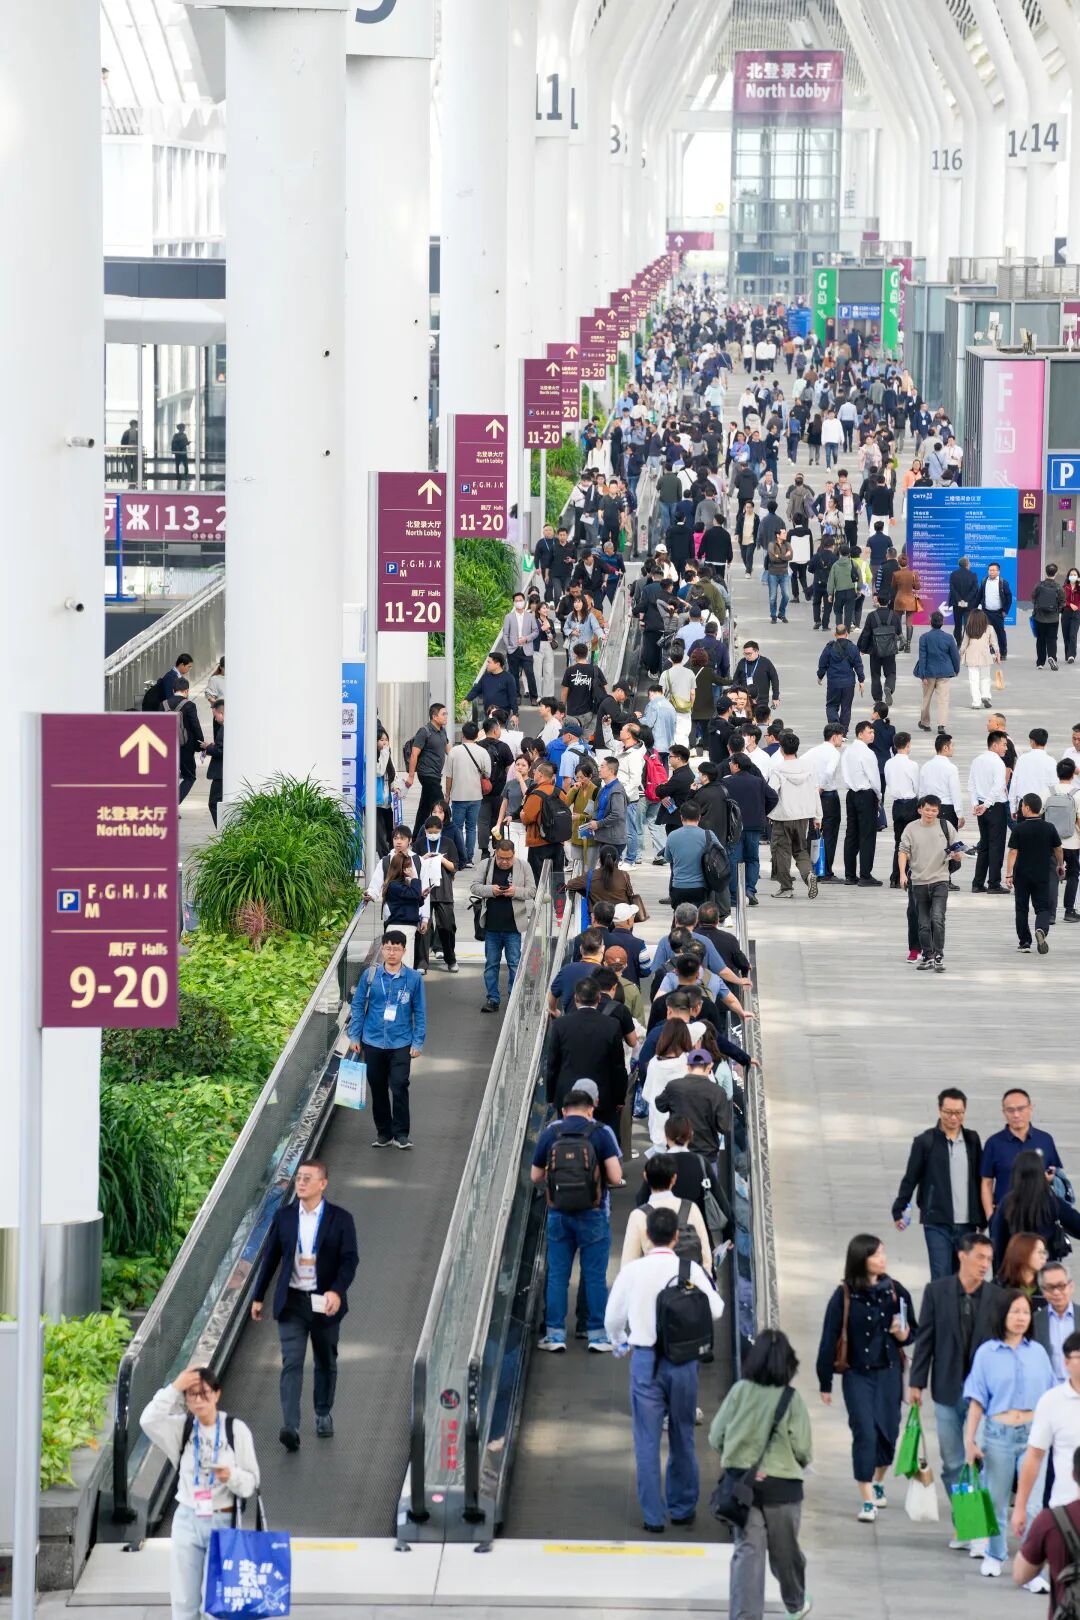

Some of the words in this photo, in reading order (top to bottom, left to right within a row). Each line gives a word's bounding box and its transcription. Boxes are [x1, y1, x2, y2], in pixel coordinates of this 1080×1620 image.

[746, 62, 832, 79] 北登录大厅
[745, 82, 785, 98] North
[790, 82, 830, 102] Lobby
[1031, 123, 1059, 152] 14
[818, 272, 828, 289] G
[581, 367, 605, 377] 13-20
[998, 374, 1013, 412] F
[527, 431, 560, 444] 11-20
[1059, 463, 1075, 486] P
[406, 520, 442, 529] 北登录大厅
[460, 514, 504, 531] 11-20
[423, 529, 441, 538] Lobby
[385, 602, 441, 623] 11-20
[97, 806, 167, 821] 北登录大厅
[96, 824, 131, 836] North
[133, 824, 167, 839] Lobby
[62, 893, 75, 909] P
[84, 903, 100, 918] M
[108, 942, 136, 957] 展厅
[141, 943, 168, 956] Halls
[69, 965, 168, 1009] 9-20
